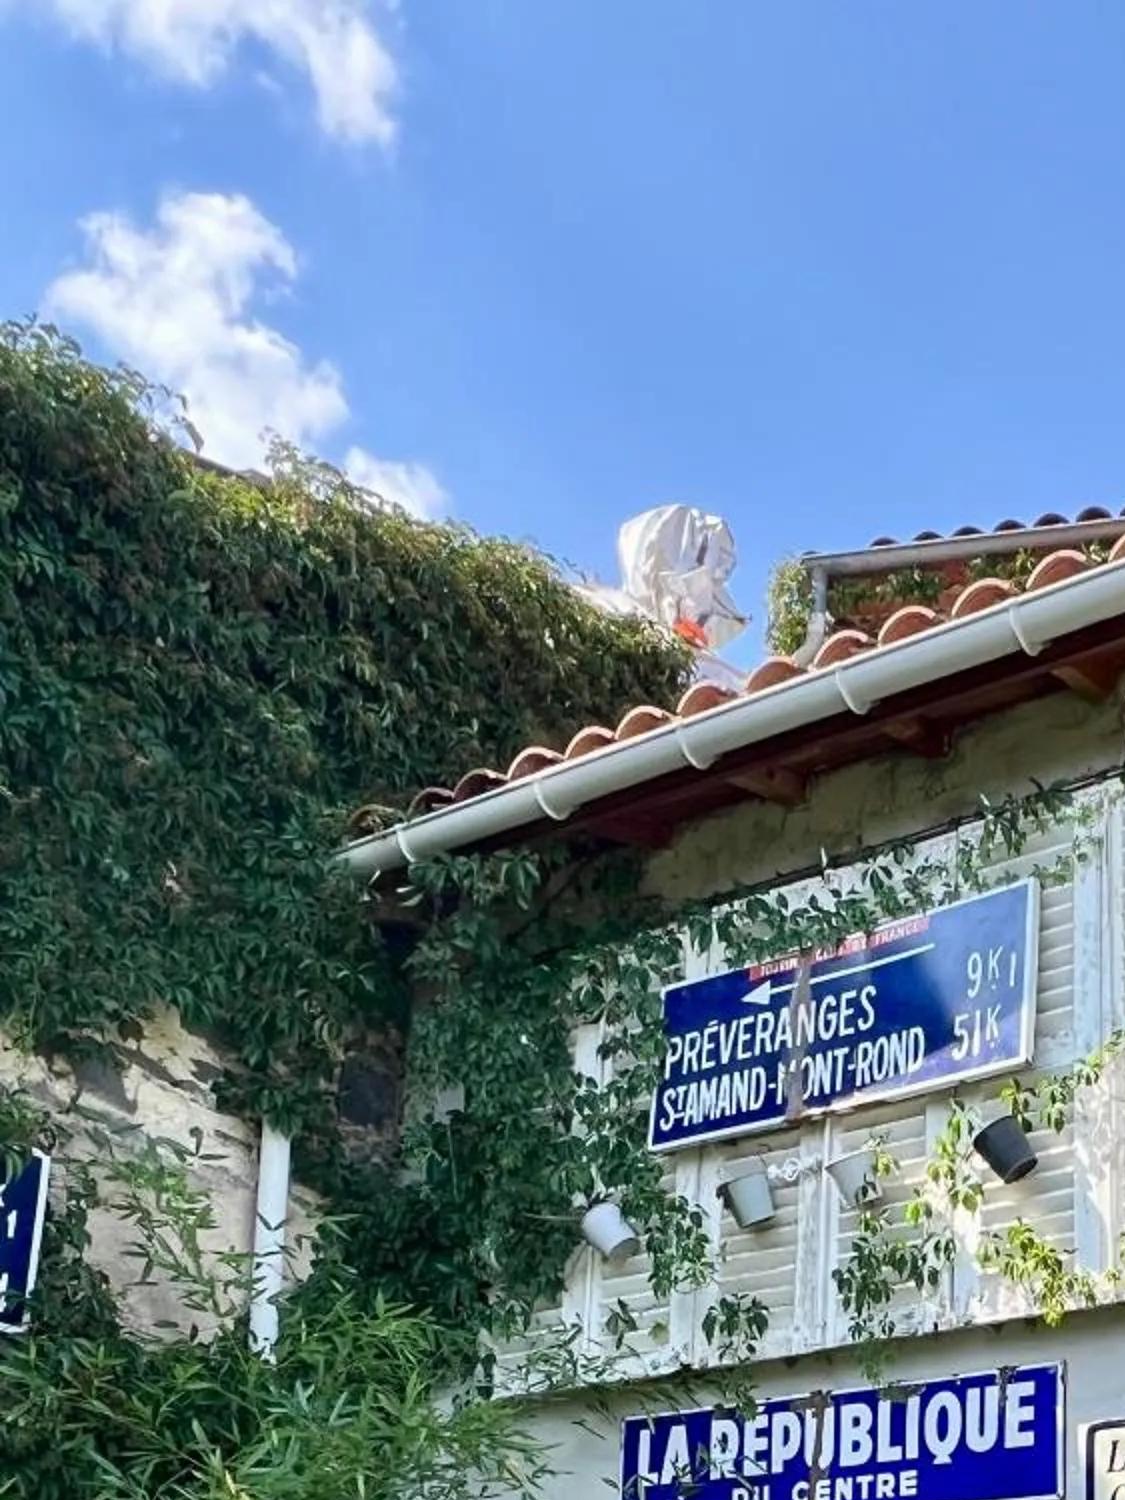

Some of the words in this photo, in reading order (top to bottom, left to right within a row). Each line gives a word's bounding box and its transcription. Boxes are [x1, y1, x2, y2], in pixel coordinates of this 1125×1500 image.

[664, 985, 877, 1079] PRÉVERANGES
[638, 1425, 692, 1486] LA
[709, 1381, 1036, 1481] RÉPUBLIQUE
